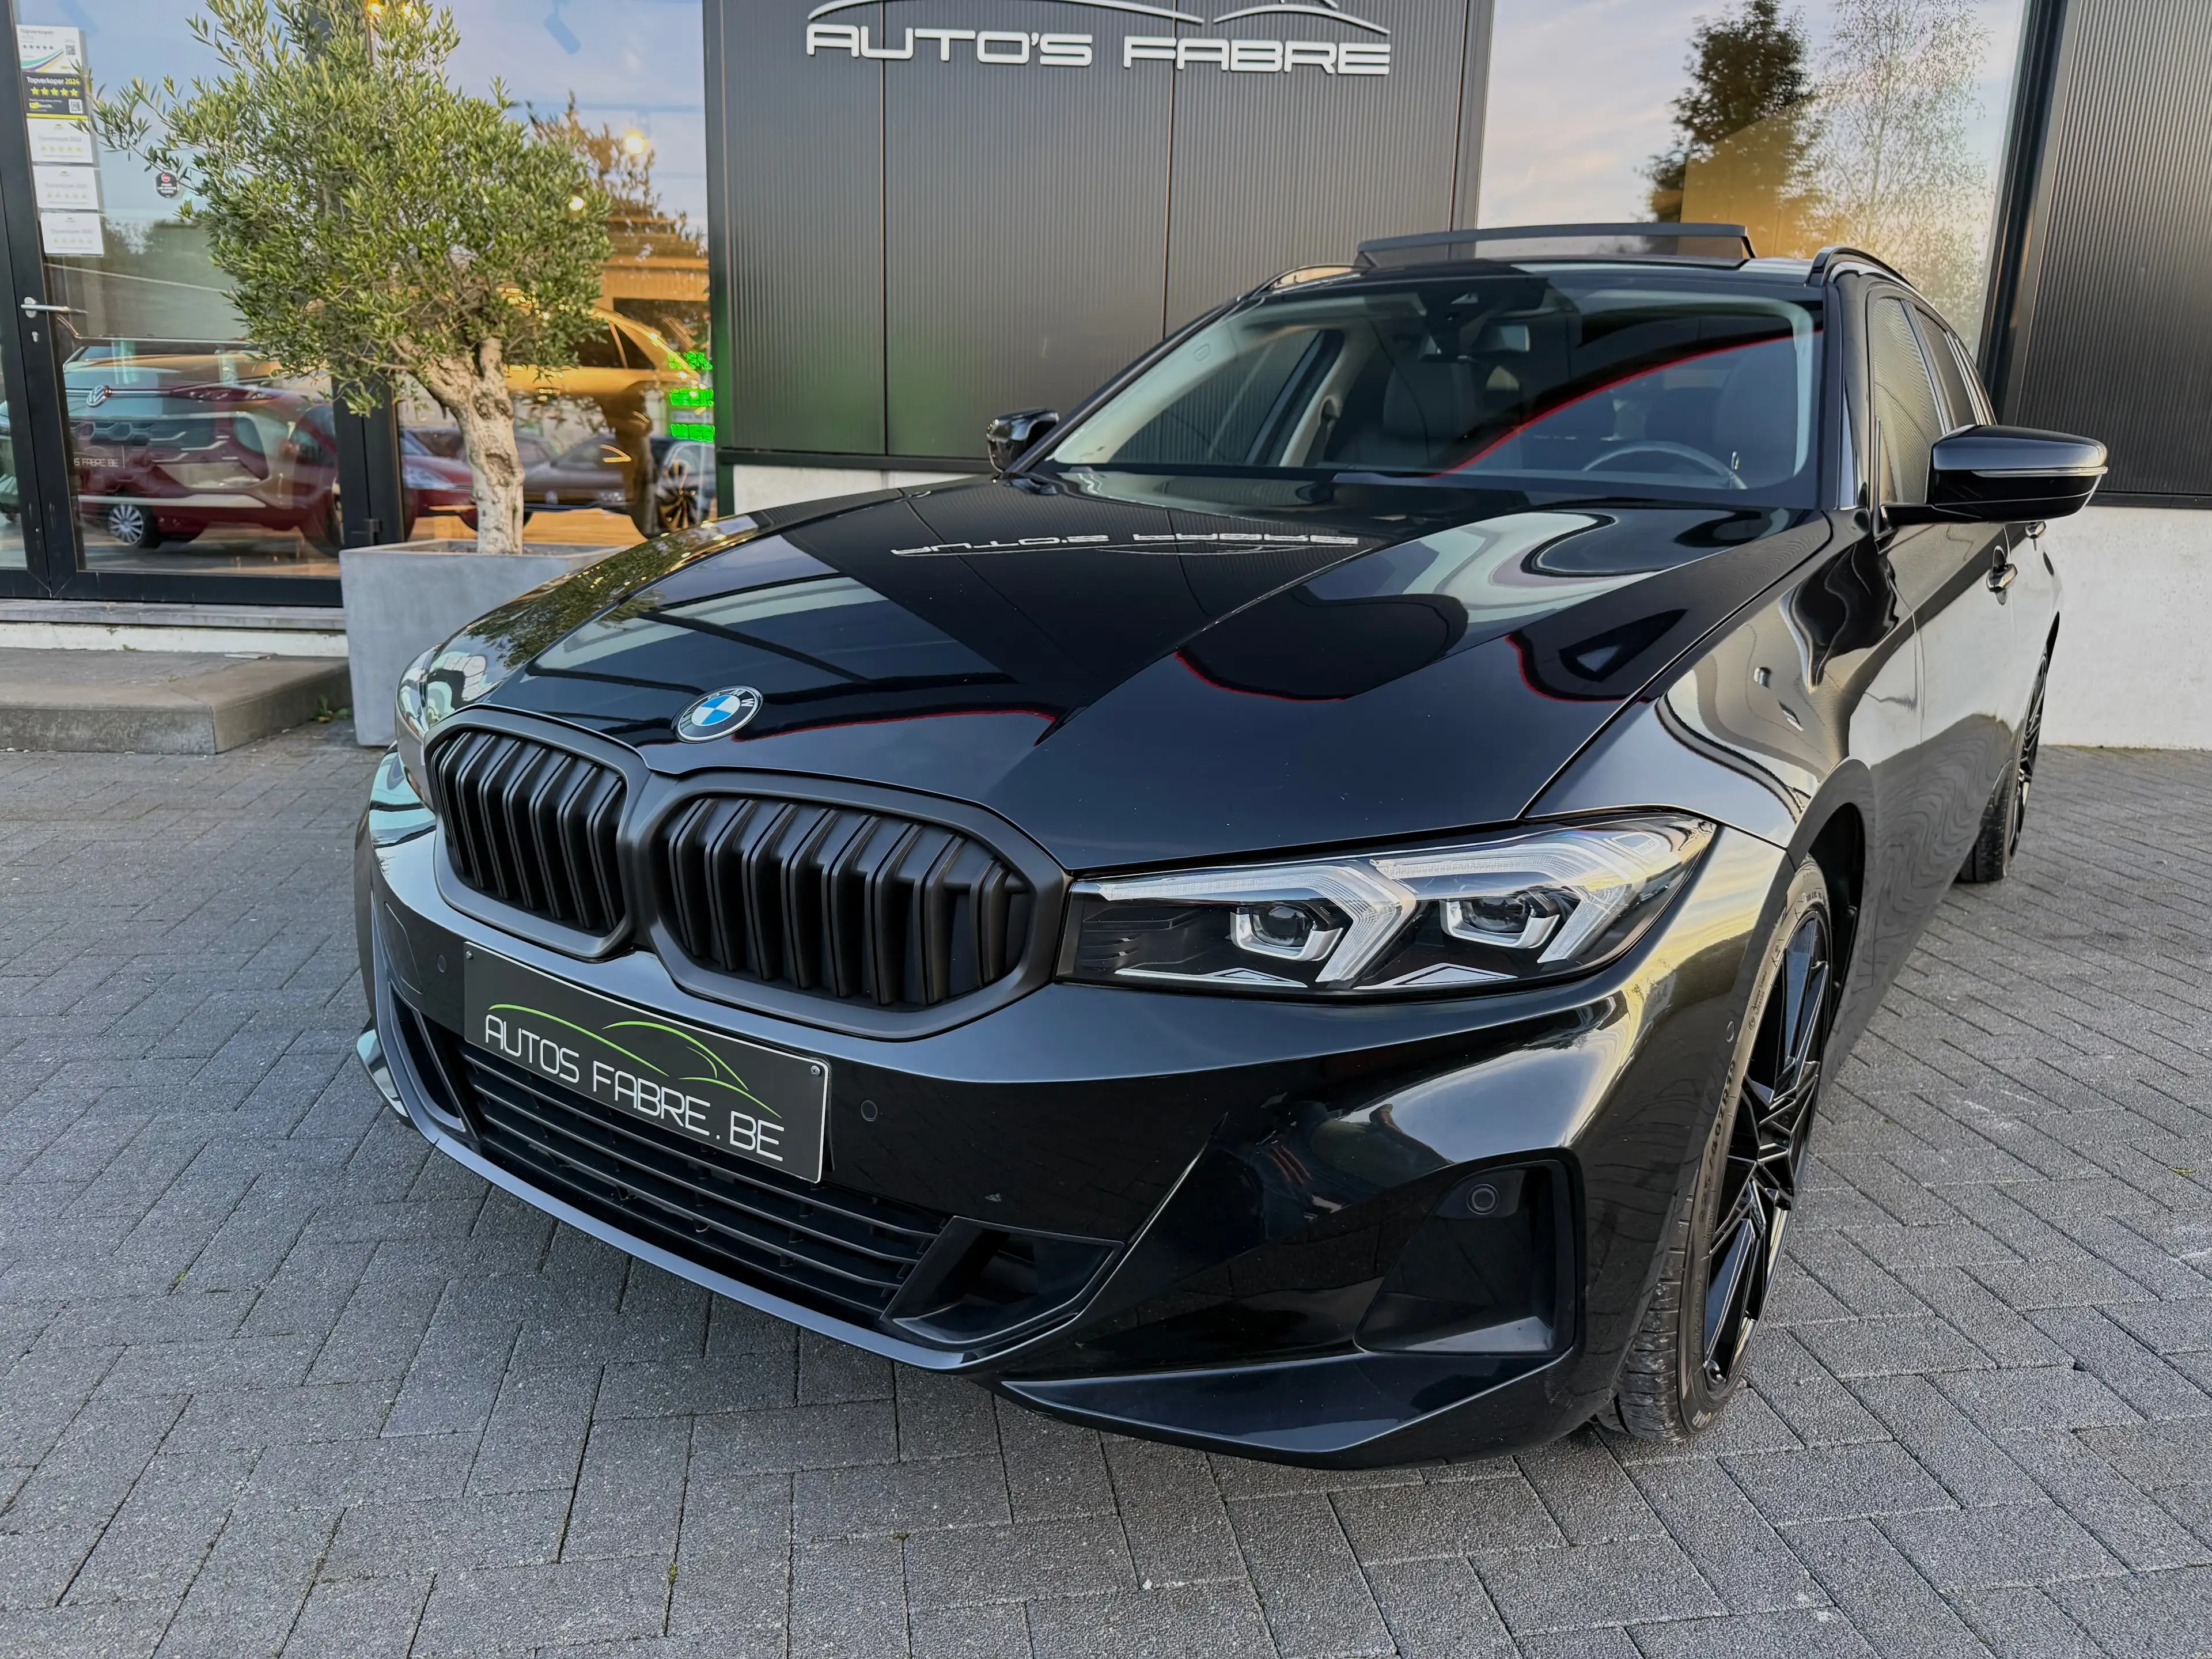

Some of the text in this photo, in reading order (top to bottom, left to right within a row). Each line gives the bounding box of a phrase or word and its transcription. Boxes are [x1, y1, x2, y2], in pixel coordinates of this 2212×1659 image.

[806, 23, 1391, 74] AUTO'S FABRE
[26, 77, 64, 85] Topverkoper
[486, 1014, 579, 1083] AUTOS
